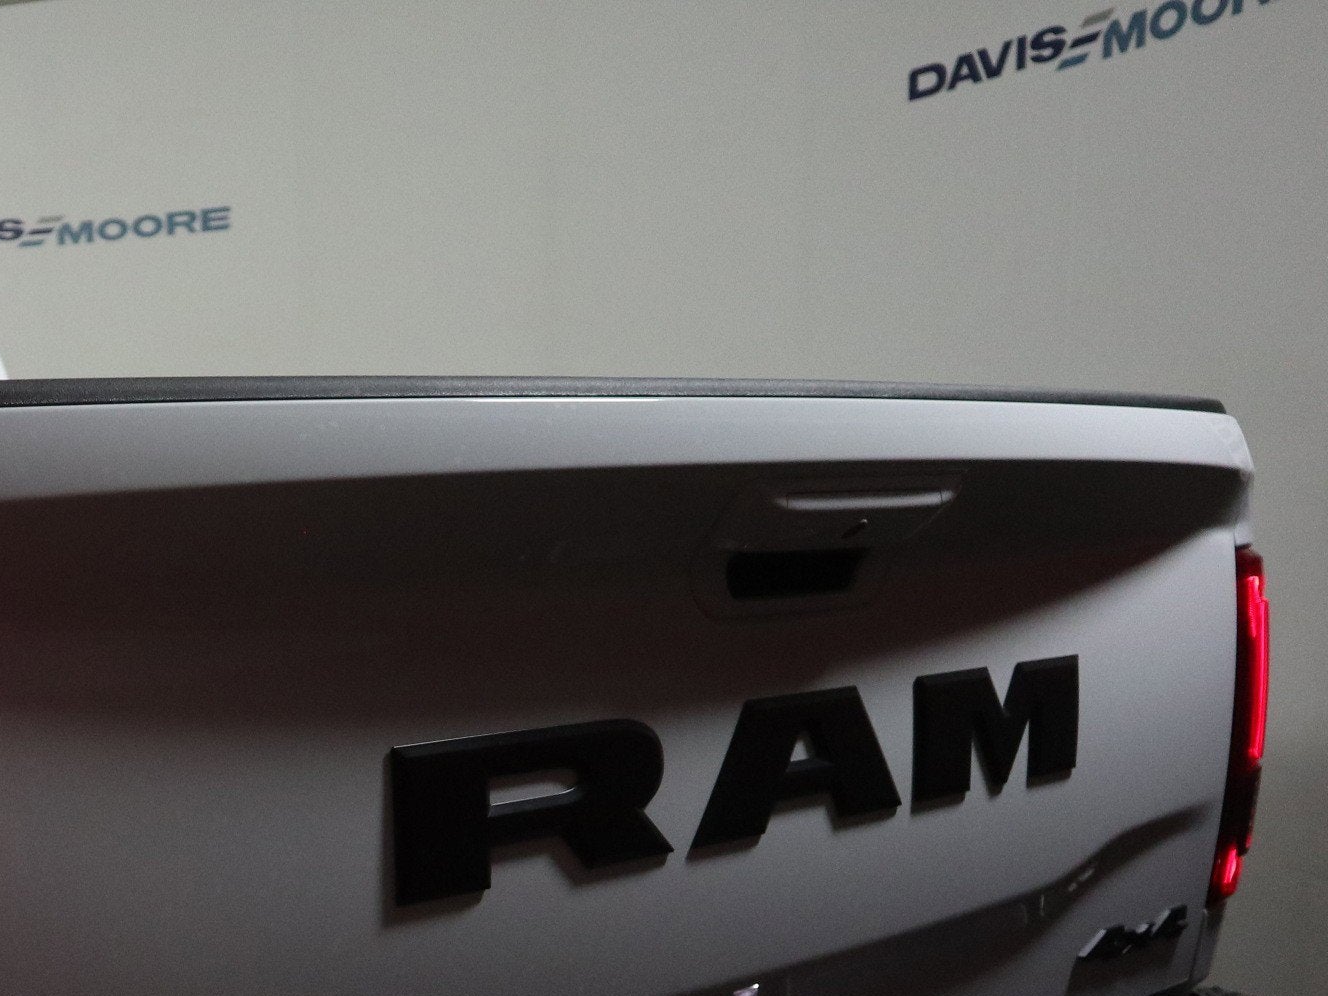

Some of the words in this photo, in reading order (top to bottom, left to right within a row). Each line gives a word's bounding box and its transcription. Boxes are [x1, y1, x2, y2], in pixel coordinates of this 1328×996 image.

[908, 25, 1067, 101] DAVIS
[1102, 0, 1271, 59] MOO
[57, 206, 231, 245] MOORE
[389, 653, 1080, 906] RAM
